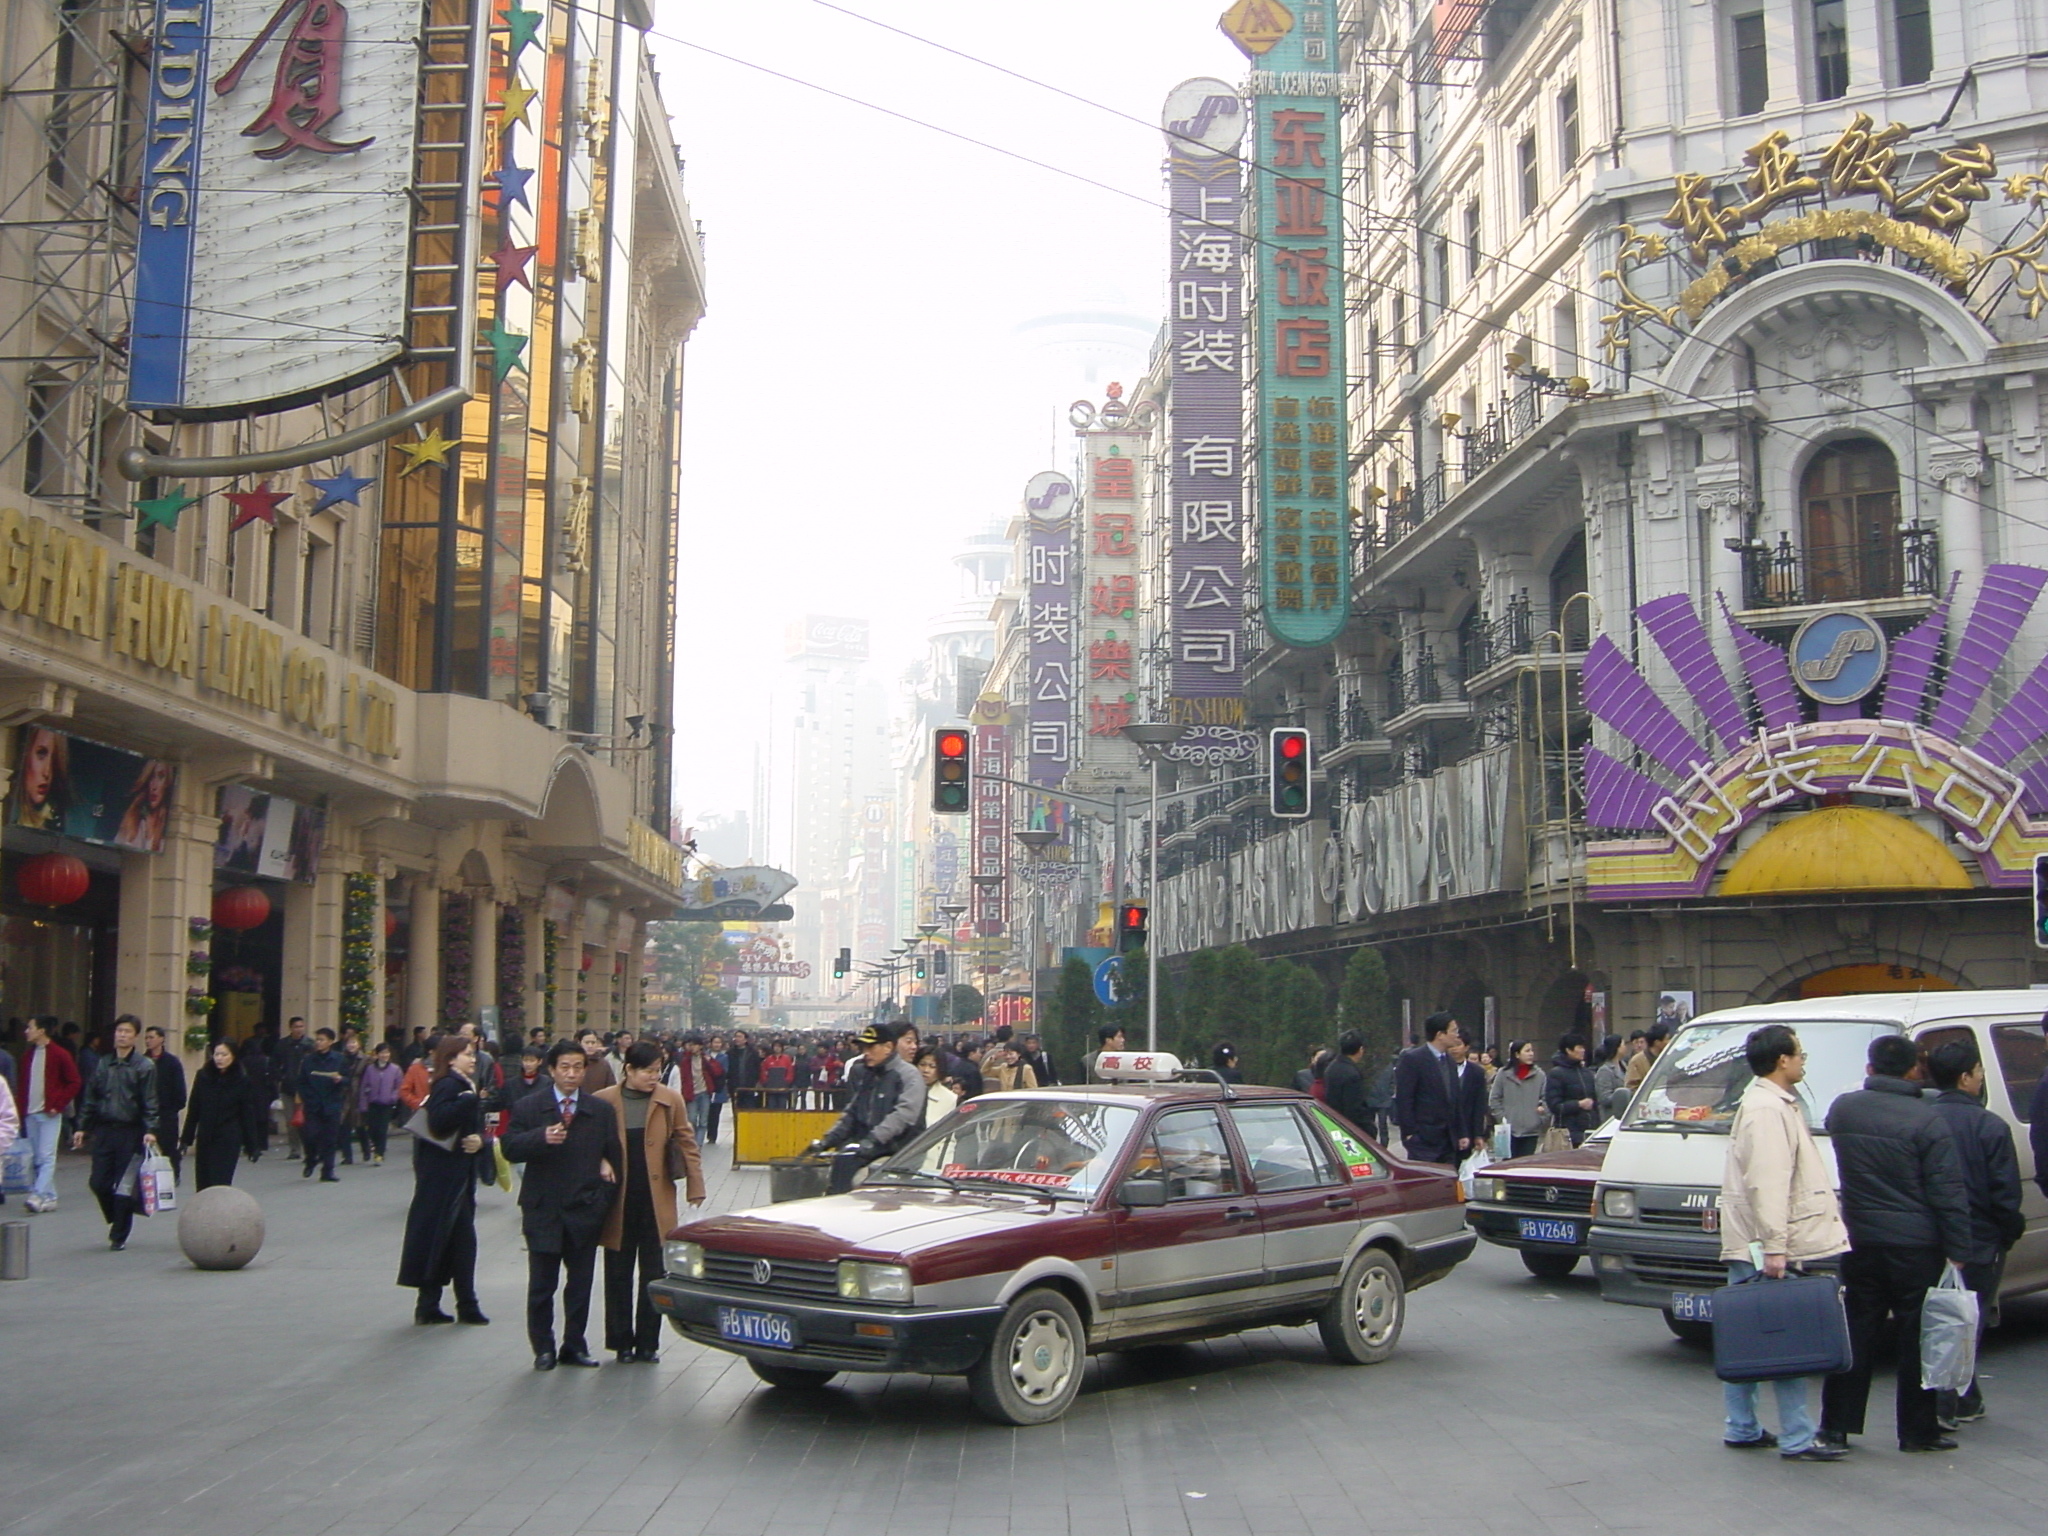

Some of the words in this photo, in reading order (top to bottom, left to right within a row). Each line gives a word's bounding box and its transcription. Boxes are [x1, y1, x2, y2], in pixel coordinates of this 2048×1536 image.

[1303, 0, 1327, 61] 集团
[1272, 108, 1331, 378] 东亚饭店
[1178, 187, 1237, 673] 上海时装有限公司
[114, 562, 194, 680] HUA
[205, 604, 284, 713] LIAN
[1031, 545, 1070, 763] 时装公司
[1171, 698, 1244, 725] FASHION
[1229, 820, 1315, 943] FASHION
[1344, 743, 1512, 918] COMPANY
[1651, 718, 2025, 864] 时装公司
[1102, 1056, 1154, 1070] 高校
[1681, 1195, 1708, 1207] JIN
